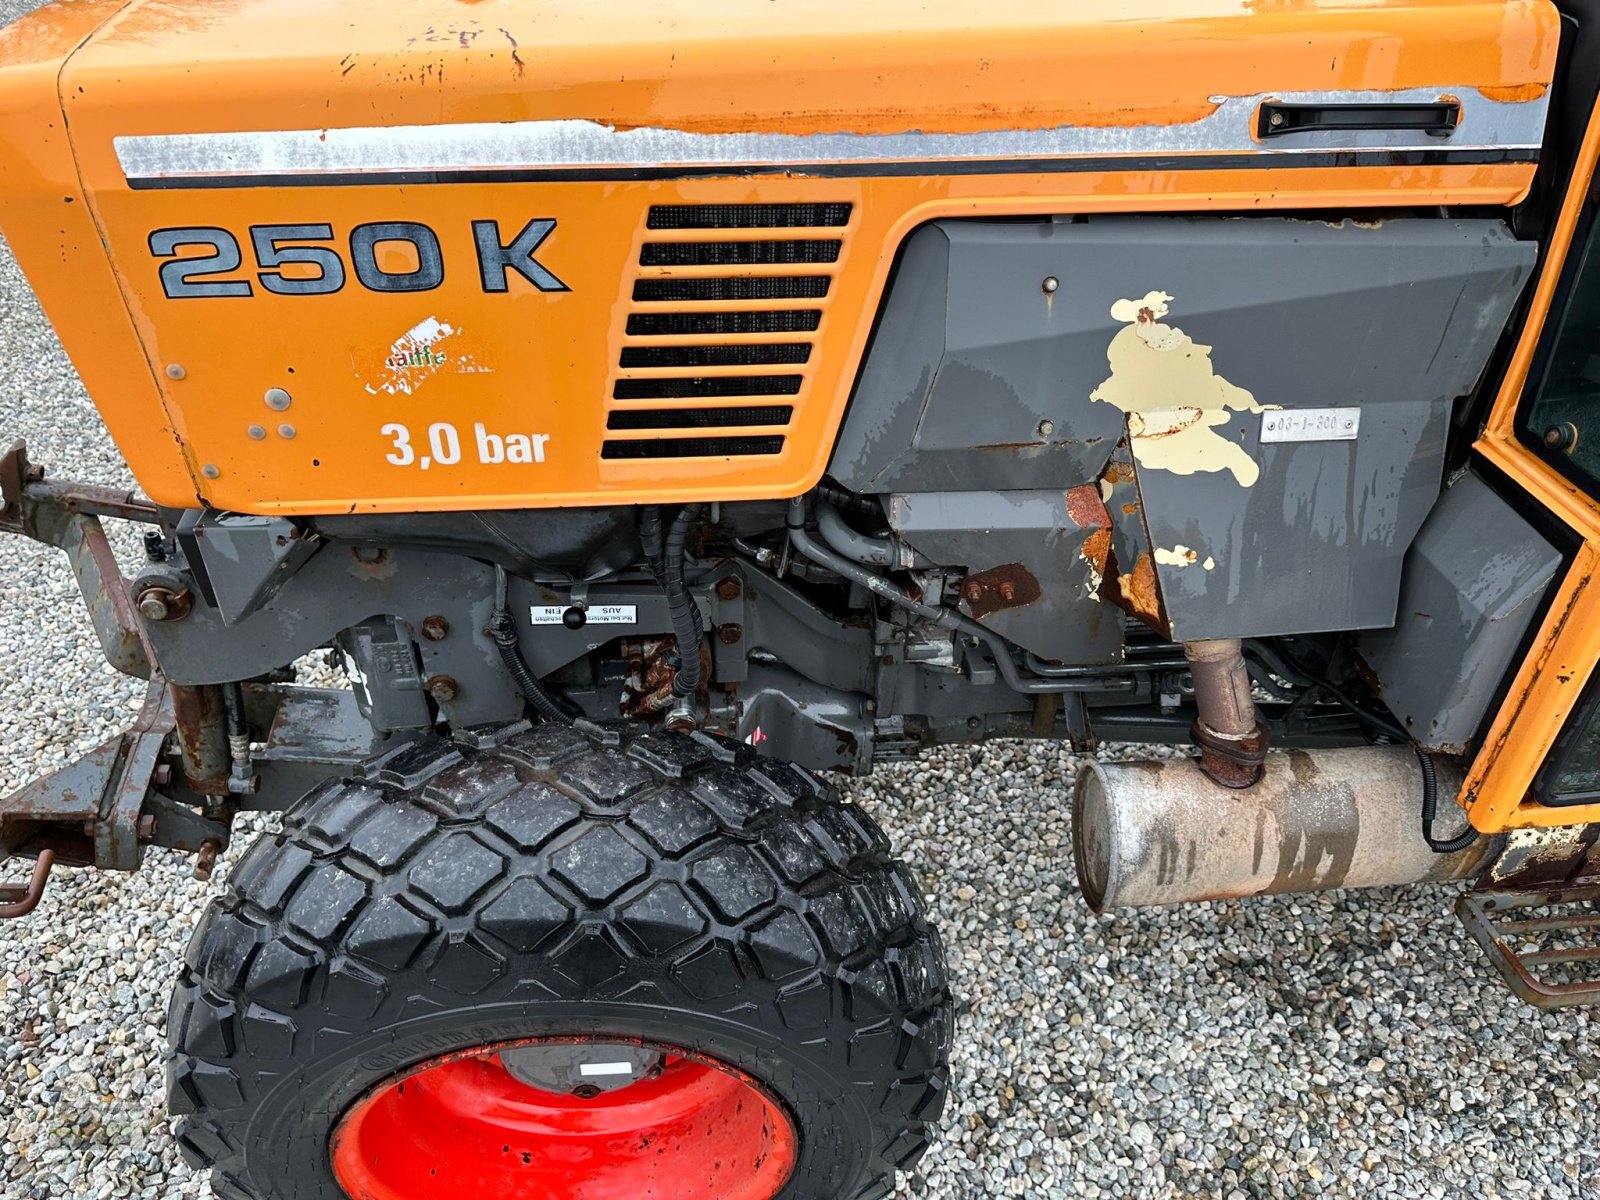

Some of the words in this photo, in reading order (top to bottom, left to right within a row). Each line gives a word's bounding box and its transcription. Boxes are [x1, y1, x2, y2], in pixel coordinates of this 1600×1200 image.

[147, 220, 445, 299] 250
[470, 217, 573, 294] K
[380, 422, 462, 471] 3,0
[474, 421, 551, 465] bar
